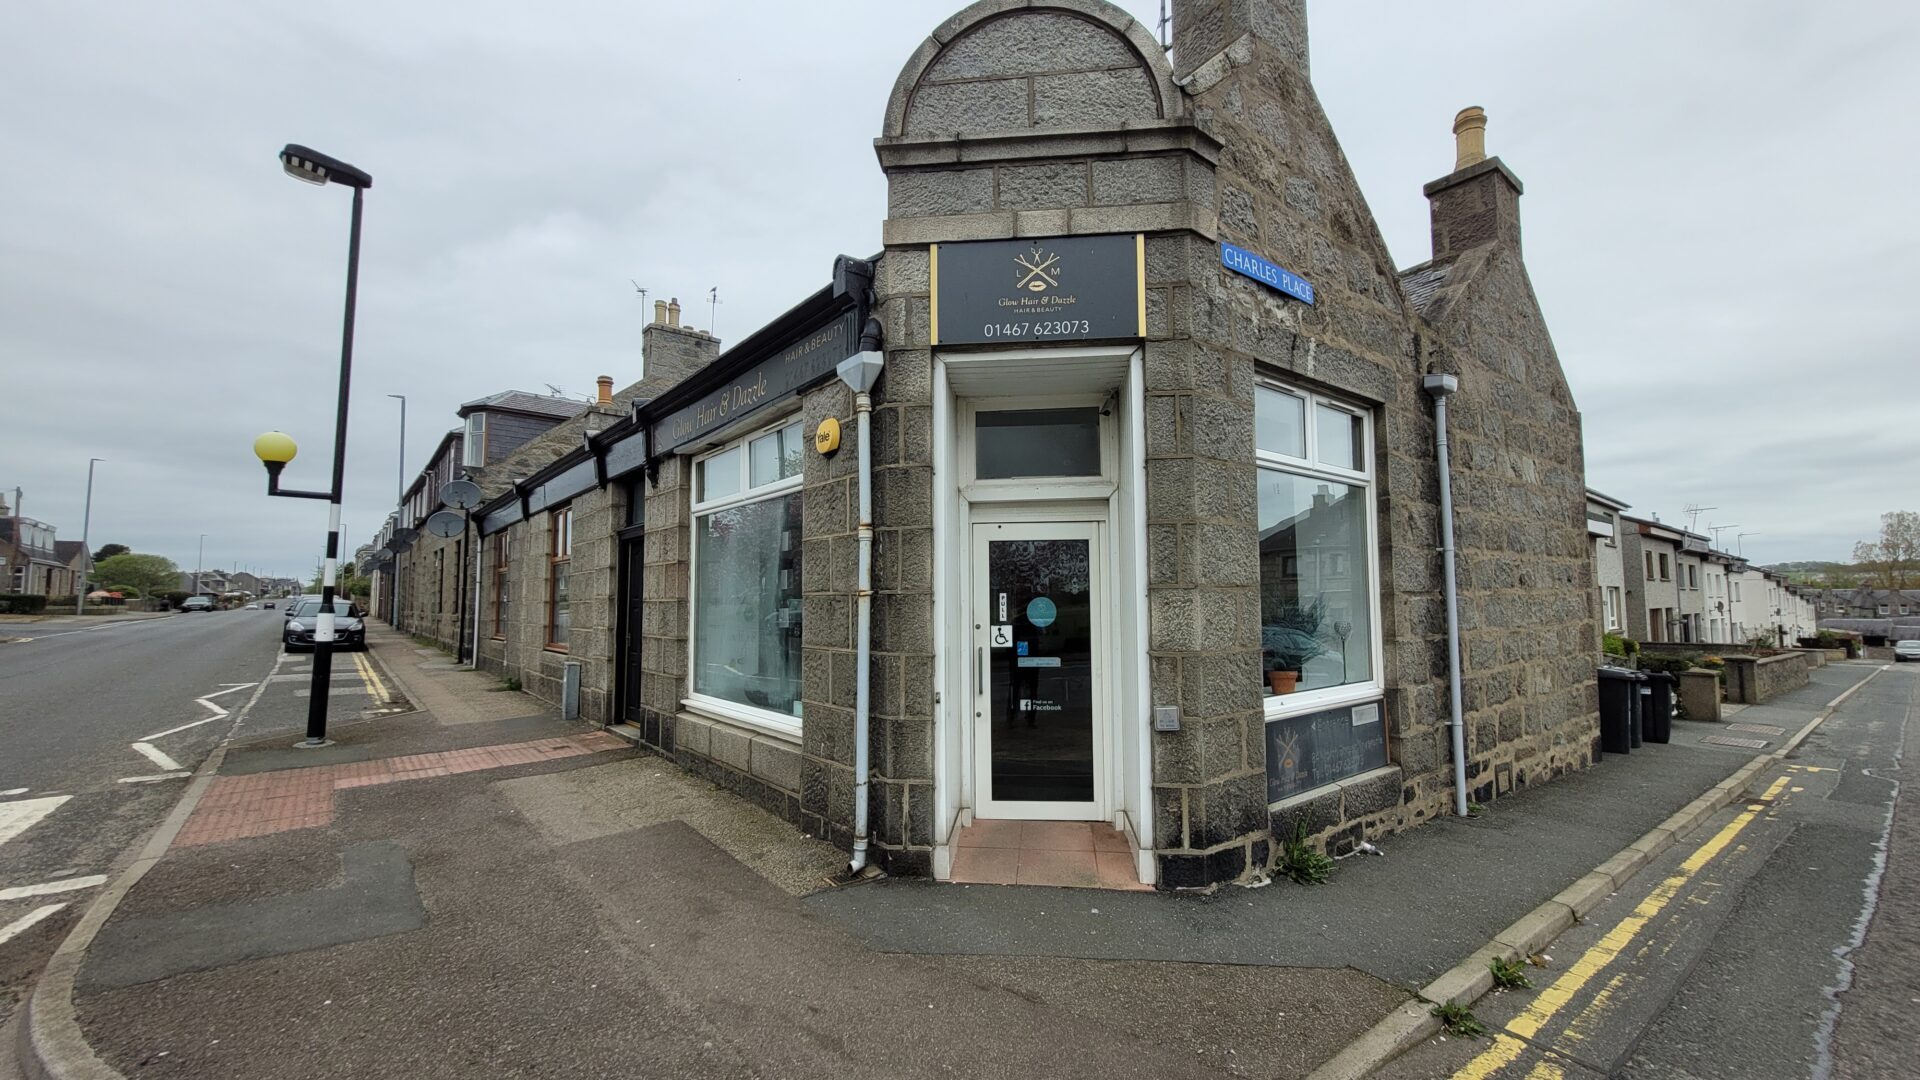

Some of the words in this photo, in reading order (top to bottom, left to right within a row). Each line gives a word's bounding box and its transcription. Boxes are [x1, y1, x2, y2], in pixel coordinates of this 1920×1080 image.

[1016, 269, 1022, 278] L
[1050, 267, 1060, 276] M
[1225, 248, 1278, 284] CHARLES
[1282, 273, 1312, 300] PLACE
[998, 297, 1019, 307] Glow
[1021, 297, 1039, 306] Hair
[1040, 296, 1049, 305] &
[1051, 294, 1077, 304] Dazzle
[984, 322, 1029, 337] 01467
[1033, 320, 1089, 335] 623073
[696, 404, 718, 429] Hair
[719, 391, 730, 417] &
[732, 371, 767, 411] Dazzle
